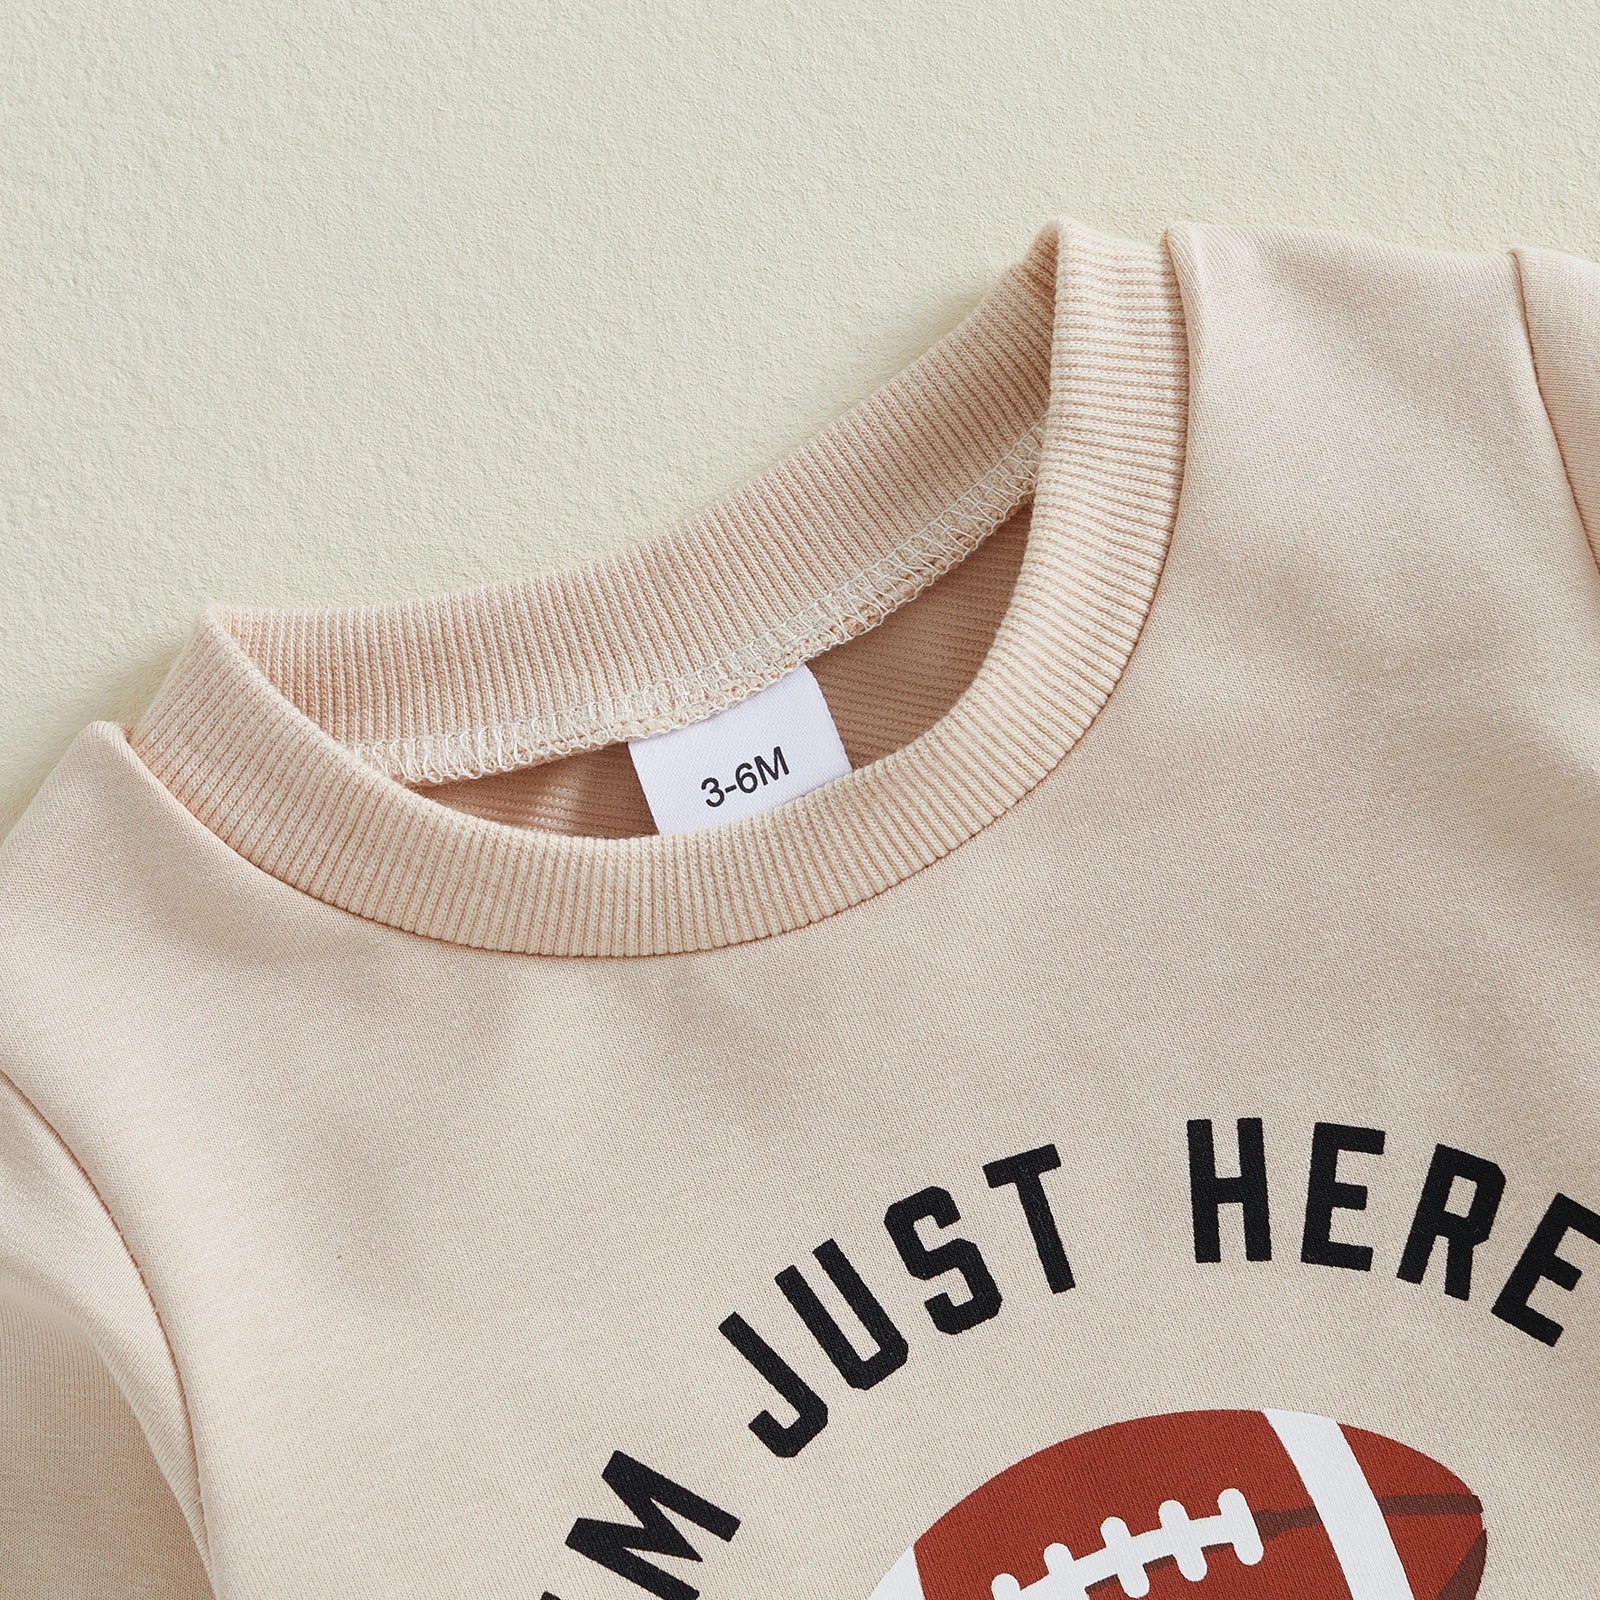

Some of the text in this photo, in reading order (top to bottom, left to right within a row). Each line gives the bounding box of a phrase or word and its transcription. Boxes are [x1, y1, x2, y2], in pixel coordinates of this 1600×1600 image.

[701, 746, 790, 808] 3-6M
[540, 1117, 1600, 1600] M JUST HERE
